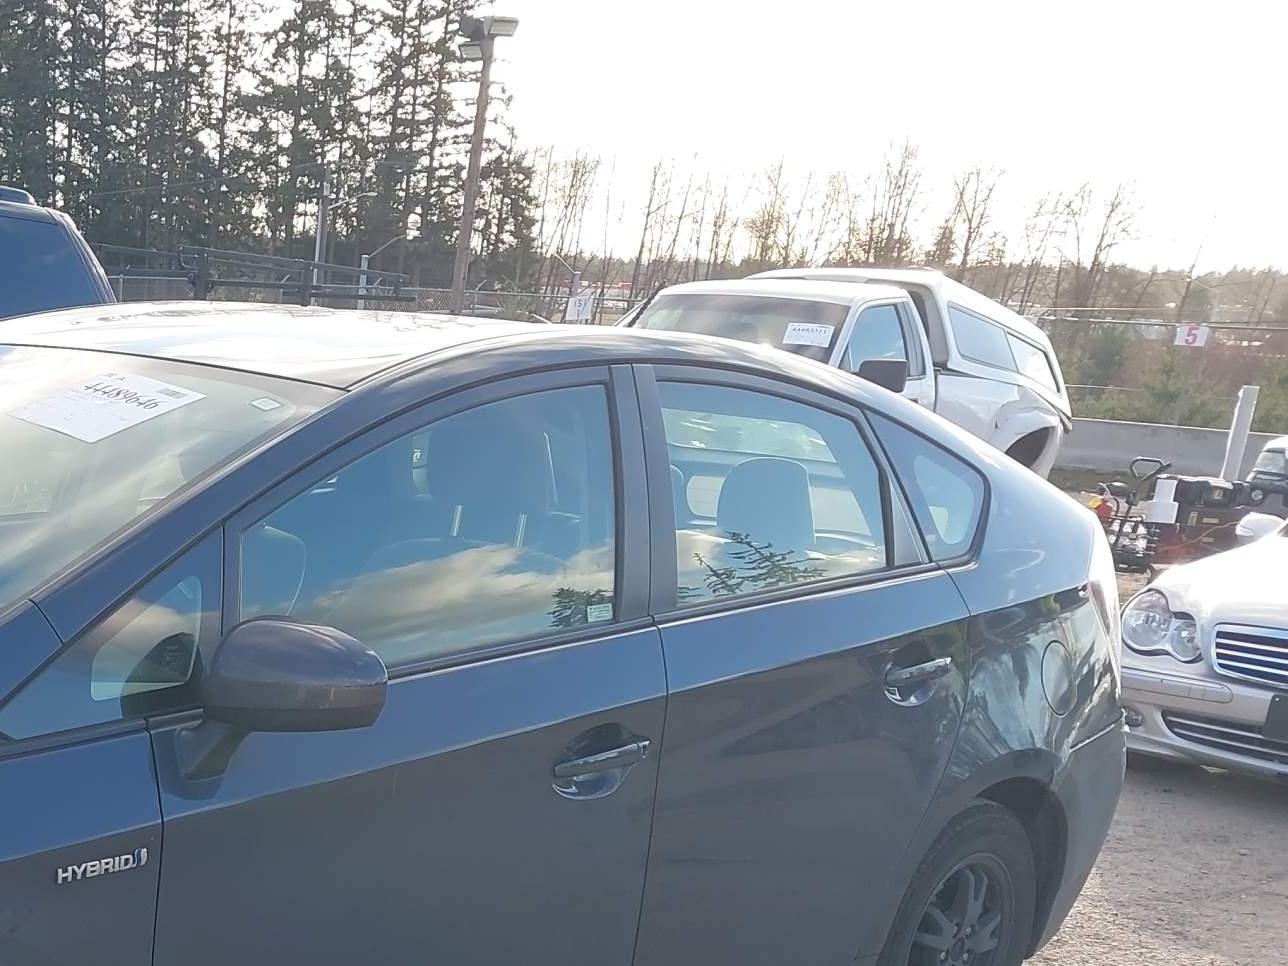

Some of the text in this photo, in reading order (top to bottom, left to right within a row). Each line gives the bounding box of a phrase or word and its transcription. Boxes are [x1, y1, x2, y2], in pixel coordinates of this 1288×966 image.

[1184, 325, 1200, 345] 5
[83, 381, 159, 410] 44489646
[56, 855, 136, 885] HYBRID
